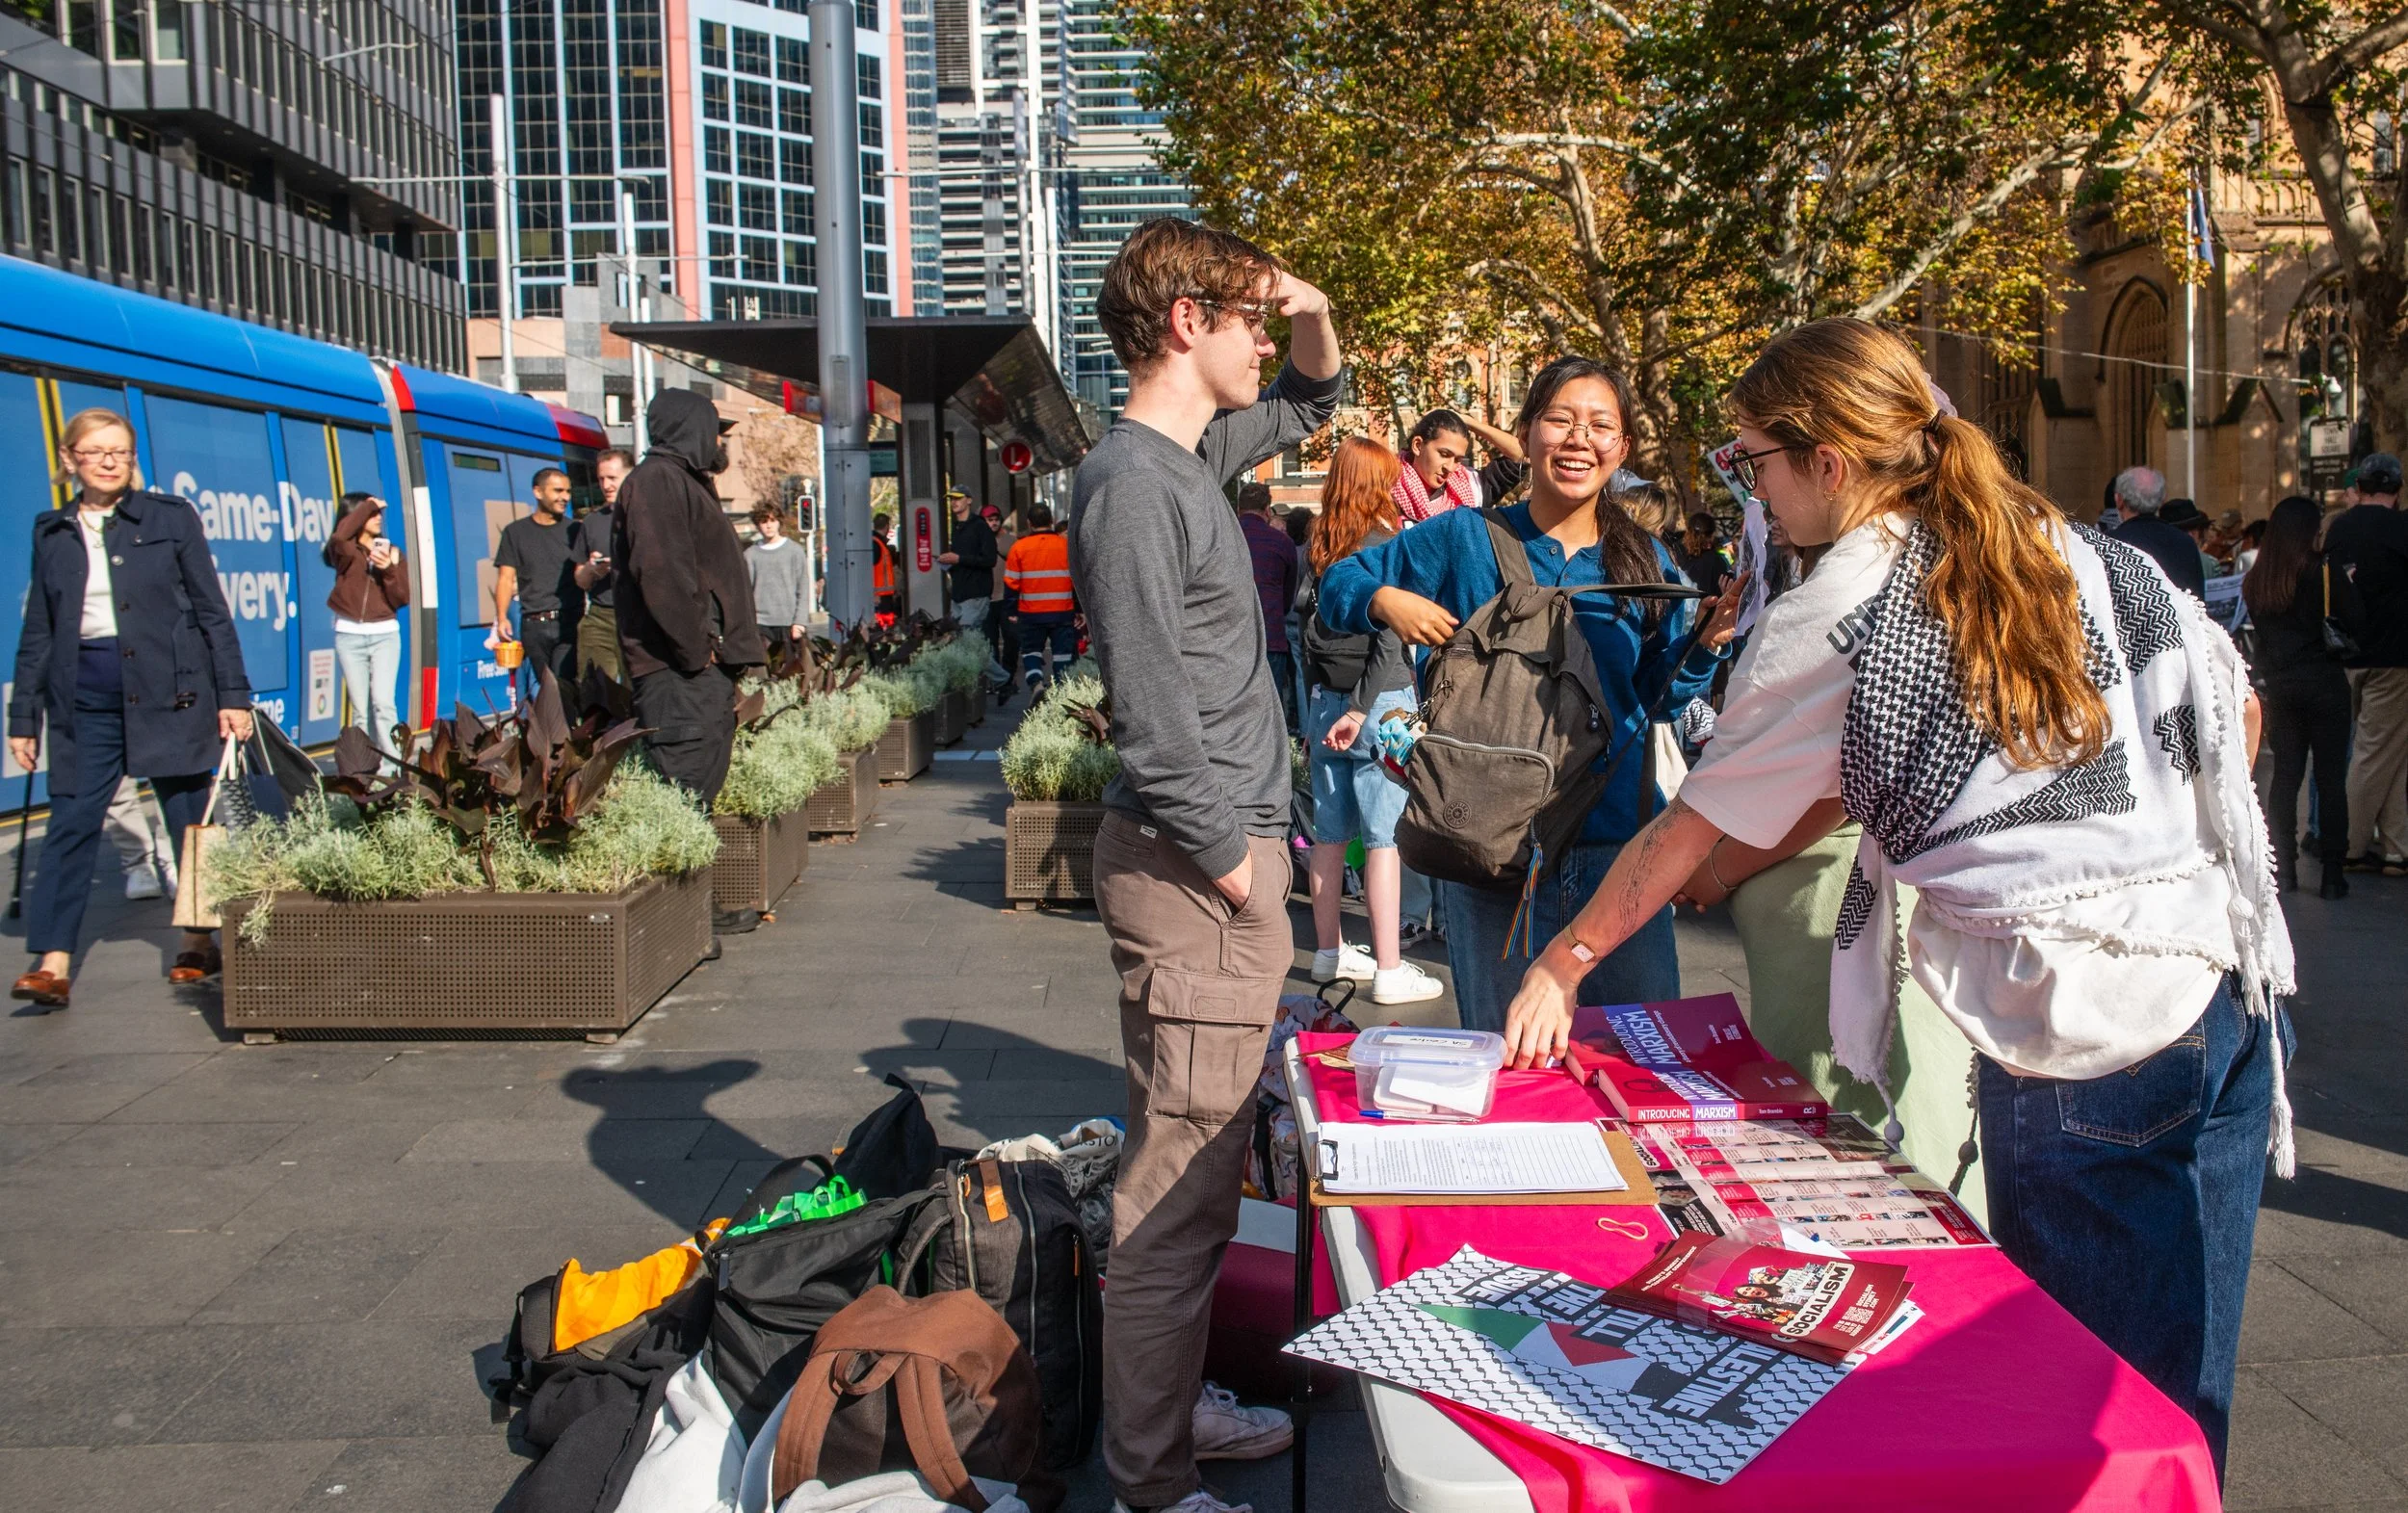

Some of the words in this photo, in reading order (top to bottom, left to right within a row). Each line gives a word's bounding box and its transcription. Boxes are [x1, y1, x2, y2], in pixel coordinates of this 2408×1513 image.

[1606, 1015, 1649, 1064] INTRODUCING
[1622, 1010, 1682, 1065] MARXISM
[1637, 1109, 1690, 1120] INTRODUCING
[1694, 1107, 1737, 1119] MARXISM
[1463, 1267, 1543, 1303] ISSUE
[1539, 1285, 1606, 1316] THE
[1786, 1265, 1849, 1336] SOCIALISM
[1580, 1309, 1654, 1338] TILL
[1661, 1343, 1784, 1419] ALESTINE
